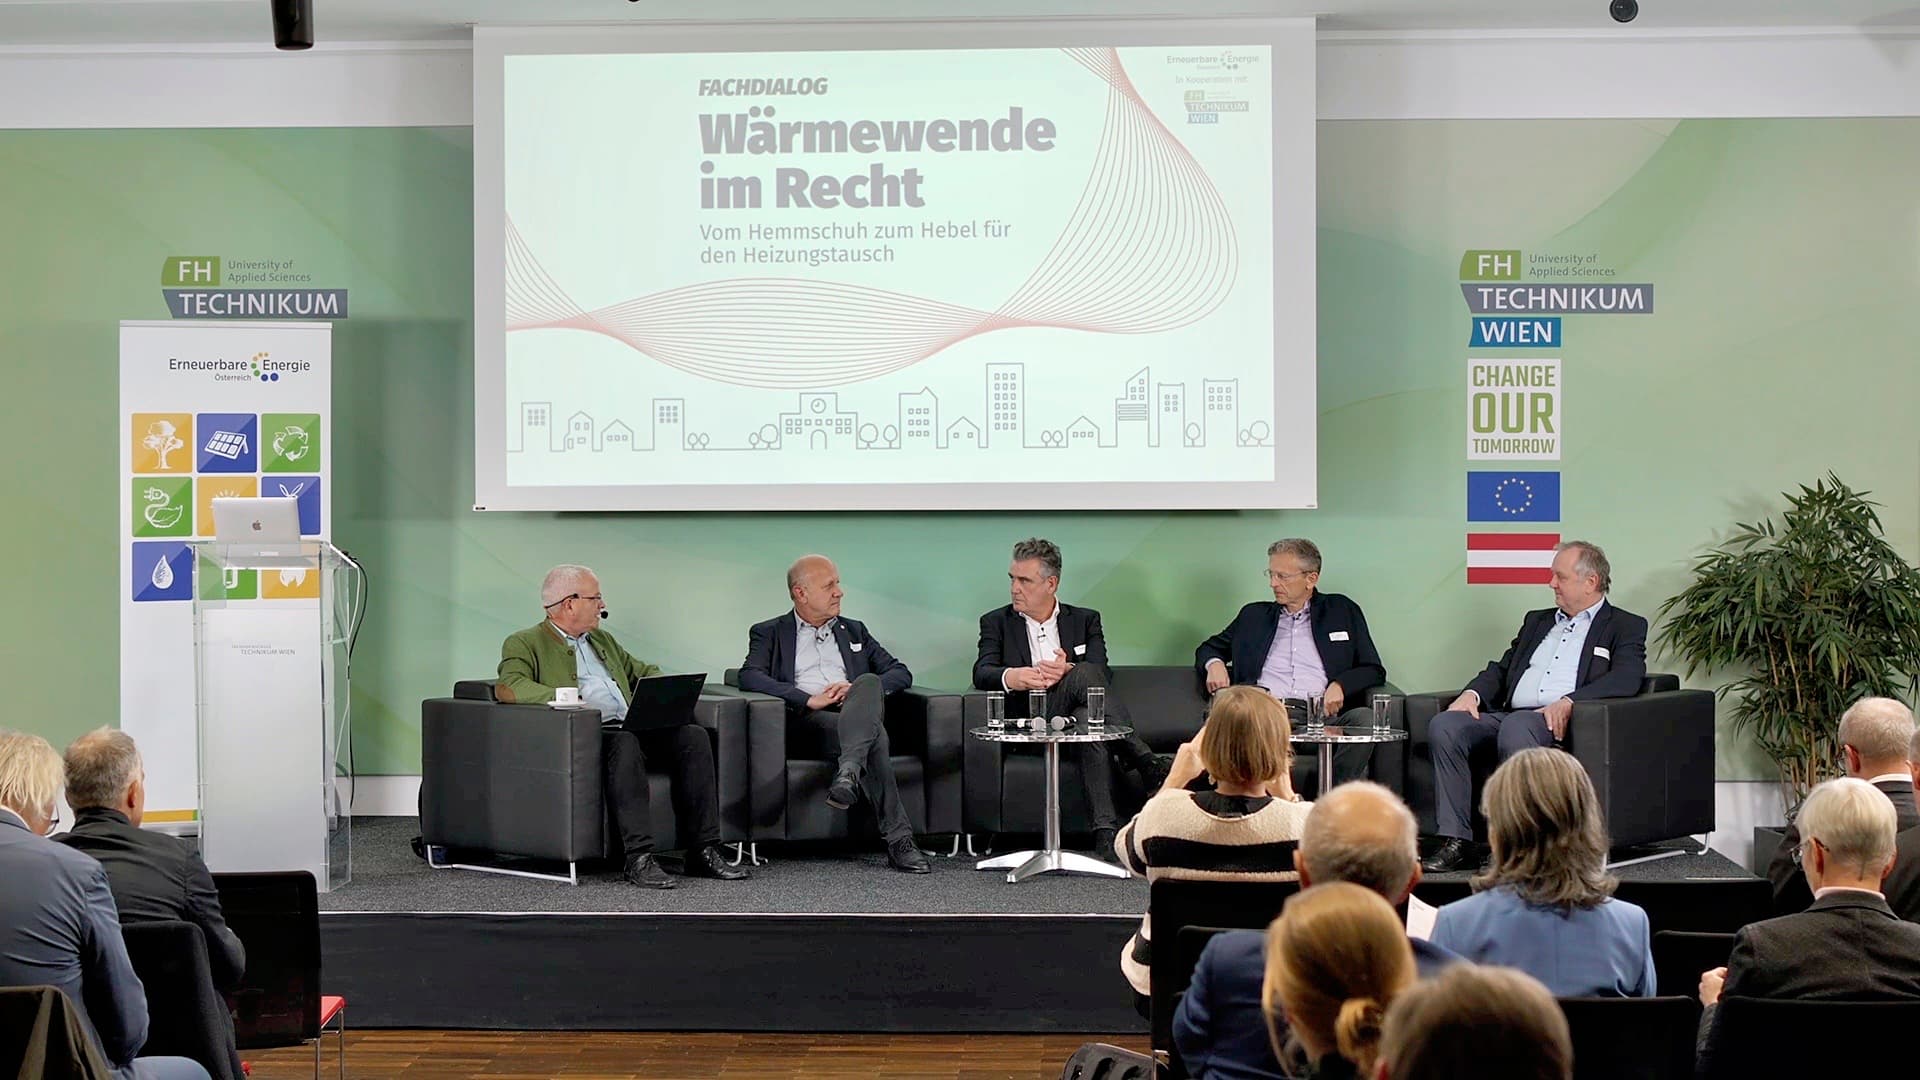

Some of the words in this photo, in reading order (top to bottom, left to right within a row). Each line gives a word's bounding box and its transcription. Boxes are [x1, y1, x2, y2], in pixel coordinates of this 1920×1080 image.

[1227, 54, 1260, 65] Energie
[698, 77, 828, 97] FACHDIALOG
[699, 105, 1057, 155] Wärmewende
[700, 160, 762, 209] im
[775, 162, 926, 209] Recht
[700, 224, 741, 241] Vom
[749, 222, 868, 240] Hemmschuh
[874, 224, 914, 240] zum
[921, 220, 977, 239] Hebel
[983, 220, 1012, 239] für
[228, 260, 280, 271] University
[283, 259, 294, 270] of
[700, 246, 736, 264] den
[744, 245, 895, 267] Heizungstausch
[1477, 254, 1513, 277] FH
[1529, 253, 1582, 266] University
[1586, 253, 1597, 264] of
[178, 260, 212, 283] FH
[228, 272, 266, 284] Applied
[269, 272, 312, 284] Sciences
[1529, 266, 1568, 279] Applied
[1572, 266, 1616, 278] Sciences
[179, 293, 339, 315] TECHNIKUM
[1477, 287, 1645, 310] TECHNIKUM
[1480, 321, 1553, 343] WIEN
[169, 358, 248, 371] Erneuerbare
[262, 359, 311, 373] Energie
[1472, 365, 1556, 387] CHANGE
[214, 372, 252, 382] Österreich
[1472, 392, 1555, 434] OUR
[1472, 438, 1556, 454] TOMORROW
